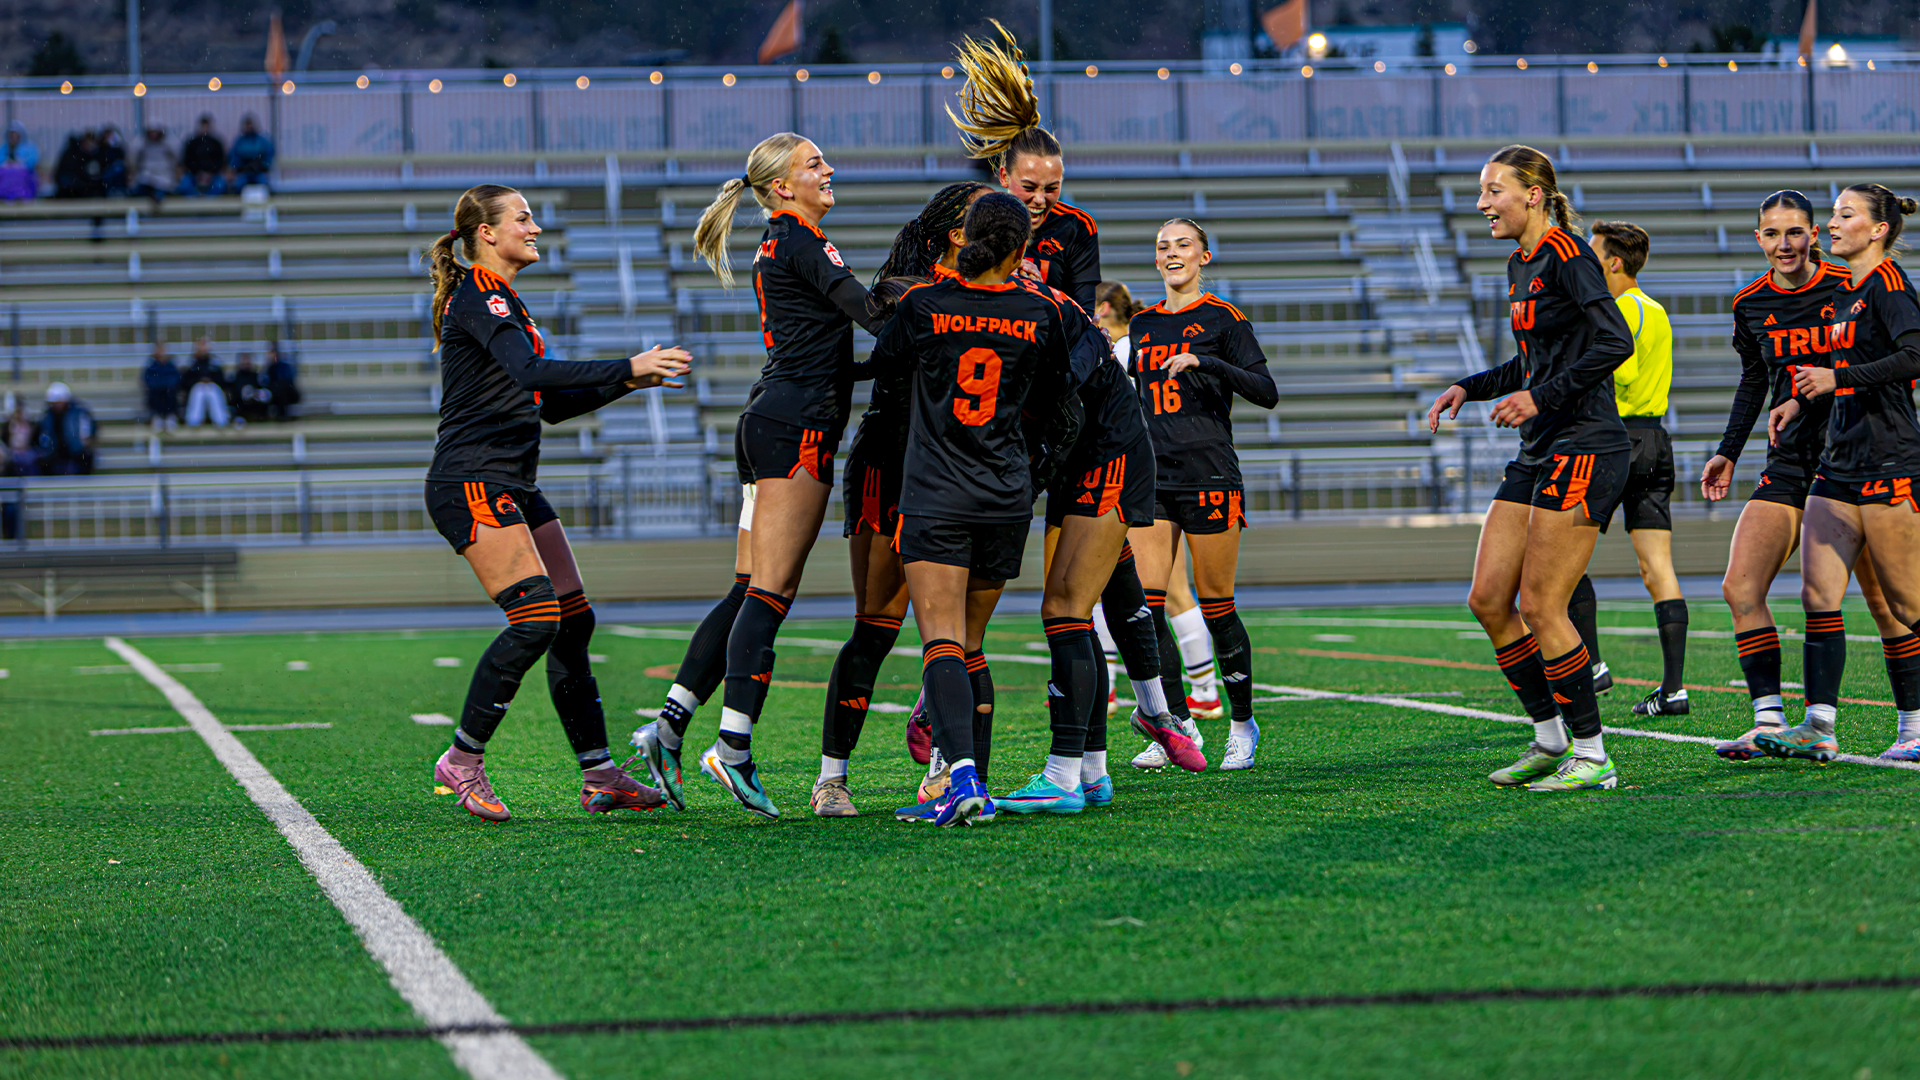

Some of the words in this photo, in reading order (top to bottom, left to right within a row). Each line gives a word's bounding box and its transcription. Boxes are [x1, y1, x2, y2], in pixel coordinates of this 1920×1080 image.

[931, 313, 1037, 343] WOLFPACK
[1767, 327, 1831, 357] TRU
[1826, 321, 1856, 352] RU
[953, 347, 1003, 426] 9
[1149, 379, 1182, 415] 16
[1550, 454, 1570, 480] 7
